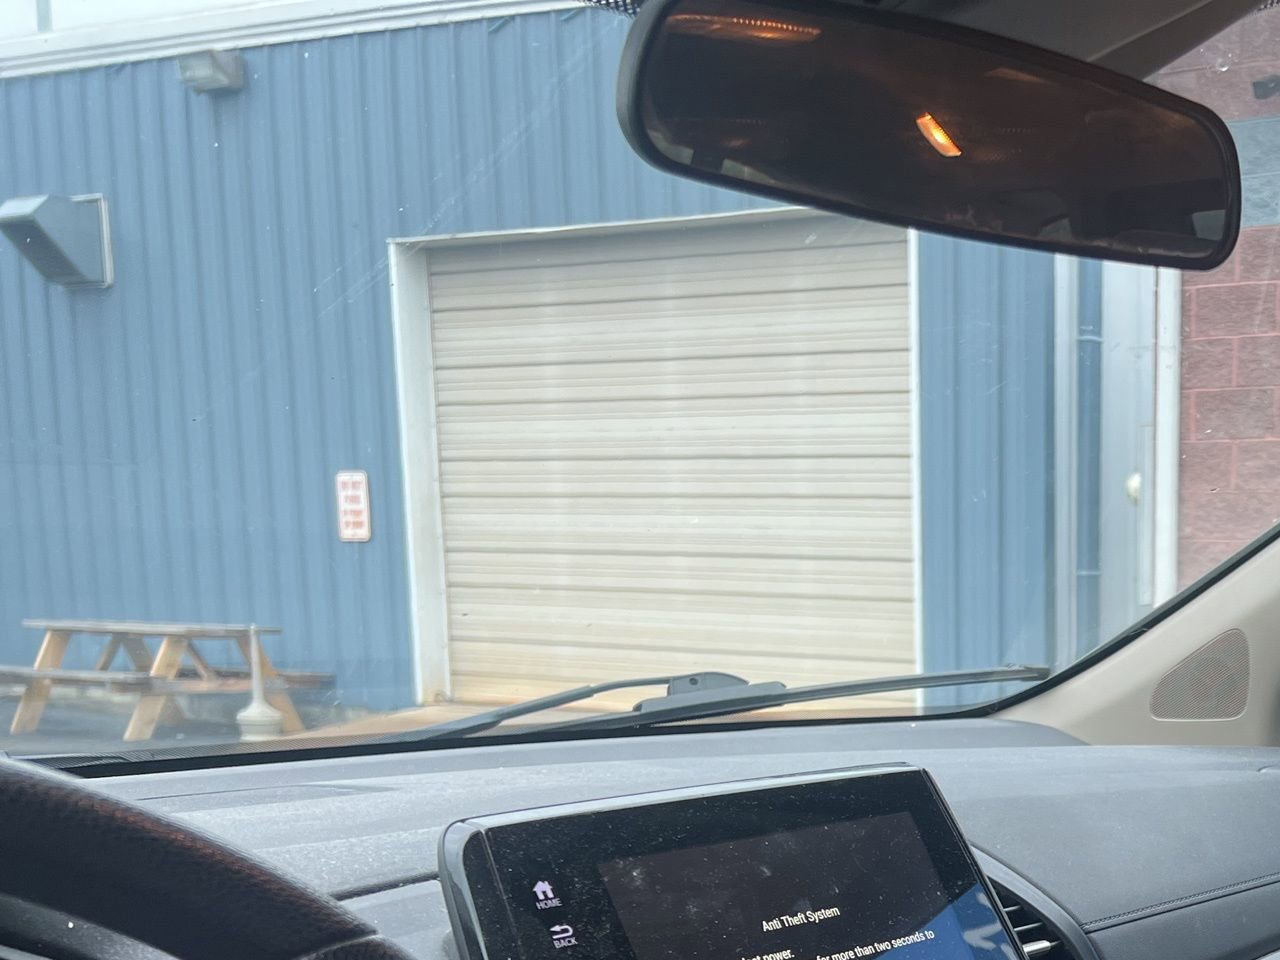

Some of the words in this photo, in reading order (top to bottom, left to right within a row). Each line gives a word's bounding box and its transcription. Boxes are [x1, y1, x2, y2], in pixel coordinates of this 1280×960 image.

[536, 898, 562, 909] HOME
[762, 918, 782, 931] Anti
[780, 913, 806, 927] Theft
[806, 907, 840, 923] System
[553, 937, 578, 949] BACK
[855, 945, 875, 957] than
[874, 941, 891, 953] two
[891, 931, 925, 947] seconds
[925, 930, 935, 939] to
